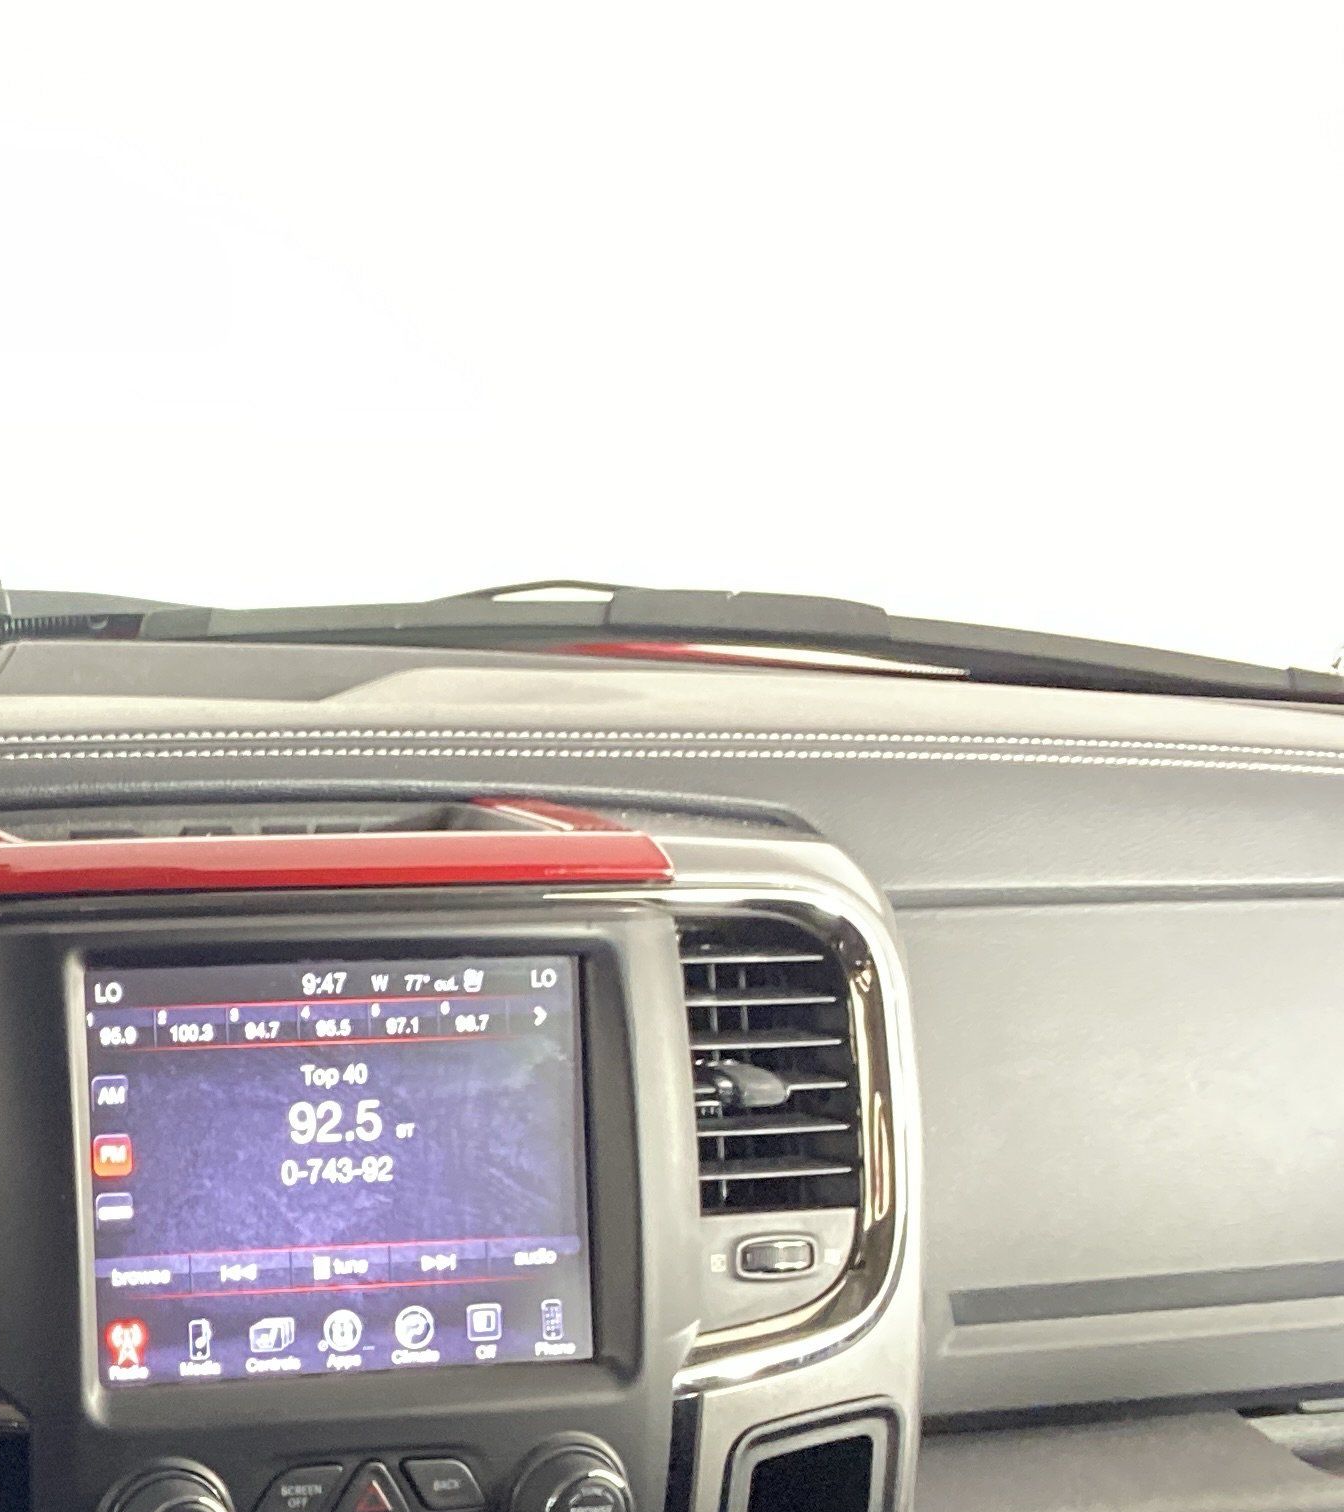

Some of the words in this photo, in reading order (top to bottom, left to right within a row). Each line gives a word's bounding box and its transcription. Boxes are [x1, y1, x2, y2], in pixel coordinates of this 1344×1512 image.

[301, 971, 347, 995] 9:47
[370, 974, 389, 992] W
[530, 968, 558, 989] LO
[94, 982, 123, 1004] LO
[300, 1063, 340, 1090] Top
[342, 1062, 369, 1085] 40
[97, 1086, 126, 1106] AM
[288, 1099, 383, 1145] 92.5
[280, 1155, 394, 1187] 0-743-92
[280, 1483, 323, 1497] SCREEN
